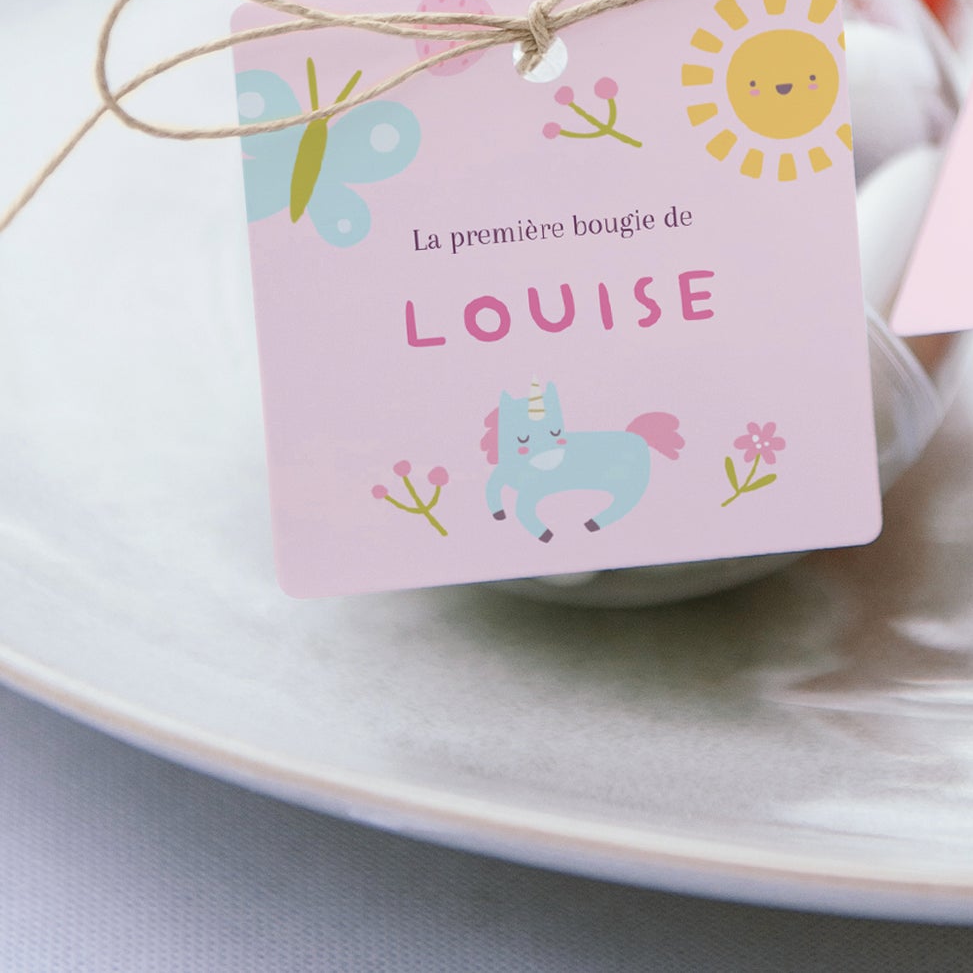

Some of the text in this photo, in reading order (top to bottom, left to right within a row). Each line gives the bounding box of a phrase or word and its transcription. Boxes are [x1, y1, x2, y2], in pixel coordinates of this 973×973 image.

[412, 205, 693, 255] La première bougie de
[405, 269, 715, 348] LOUISE
